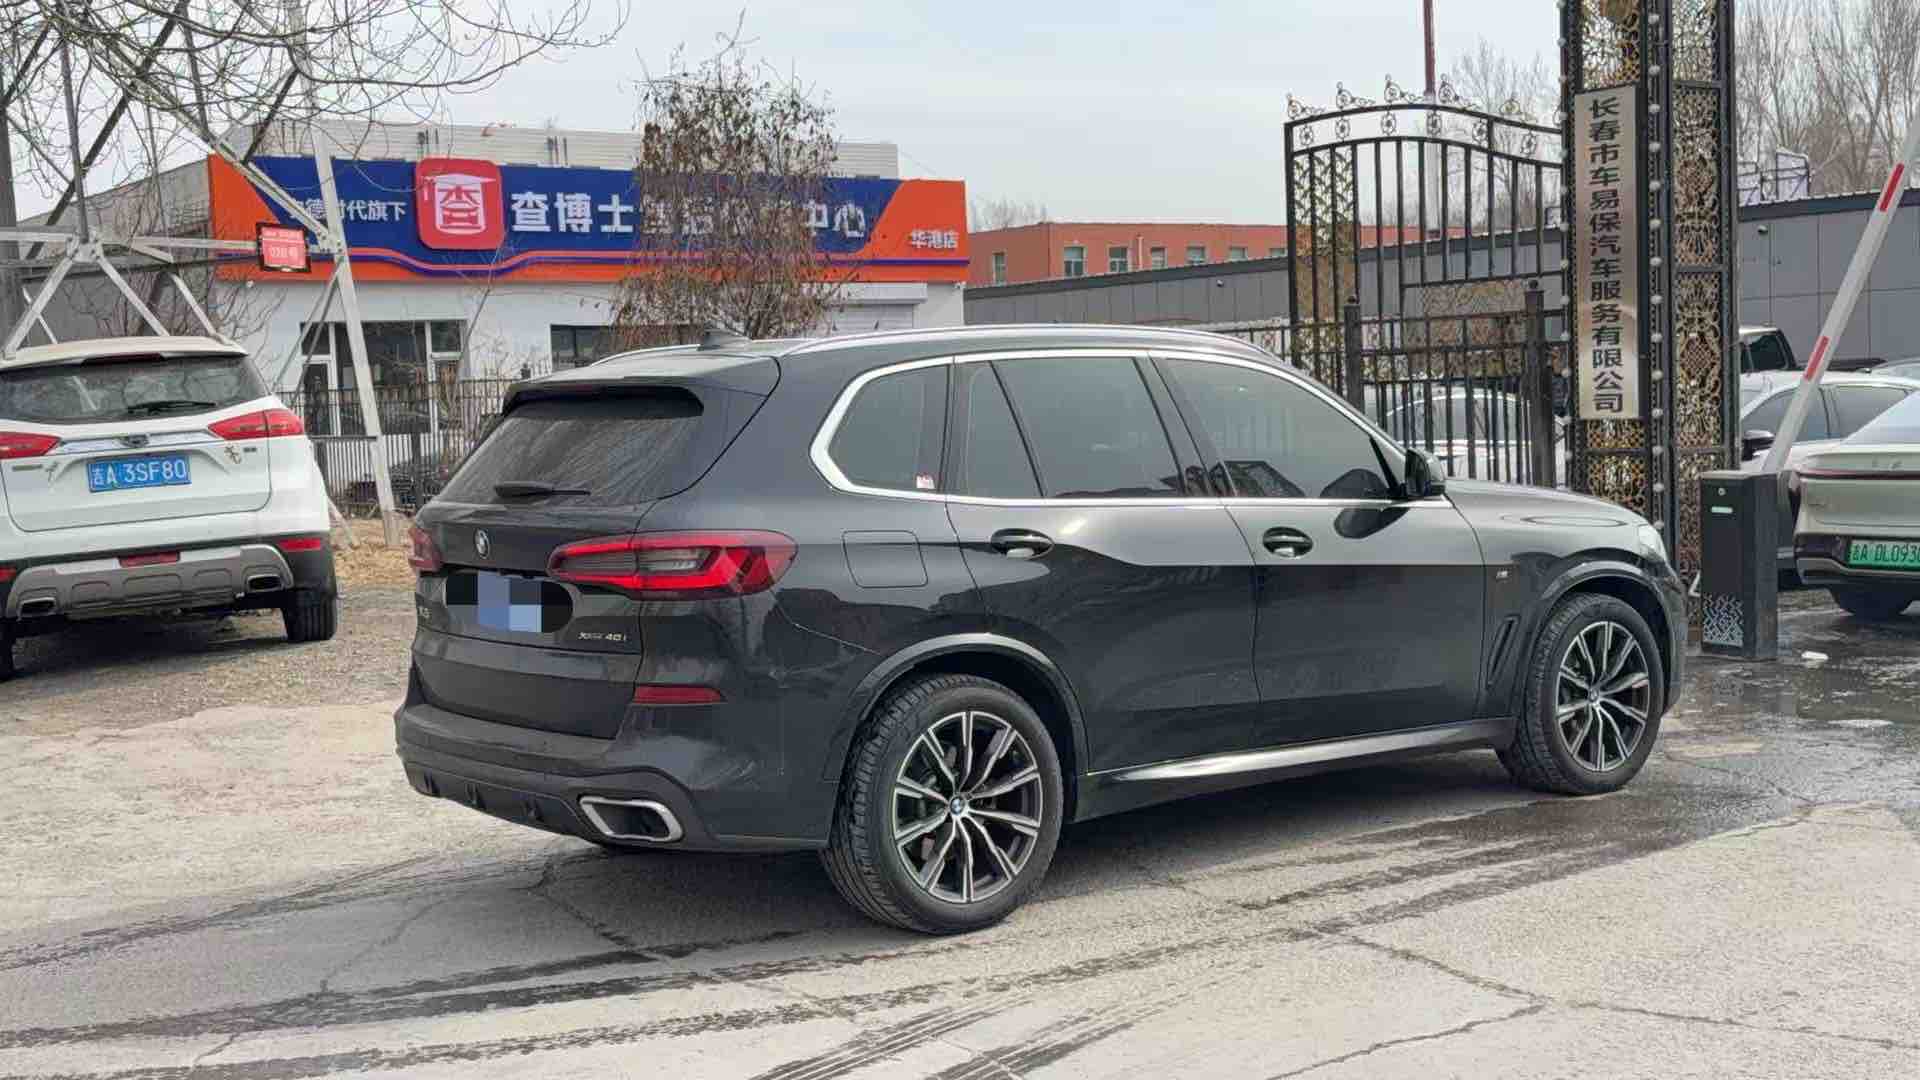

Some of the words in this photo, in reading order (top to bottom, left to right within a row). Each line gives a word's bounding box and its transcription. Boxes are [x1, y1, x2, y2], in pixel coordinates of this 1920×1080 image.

[1588, 97, 1624, 414] 长春市车易保汽车服务有限公司
